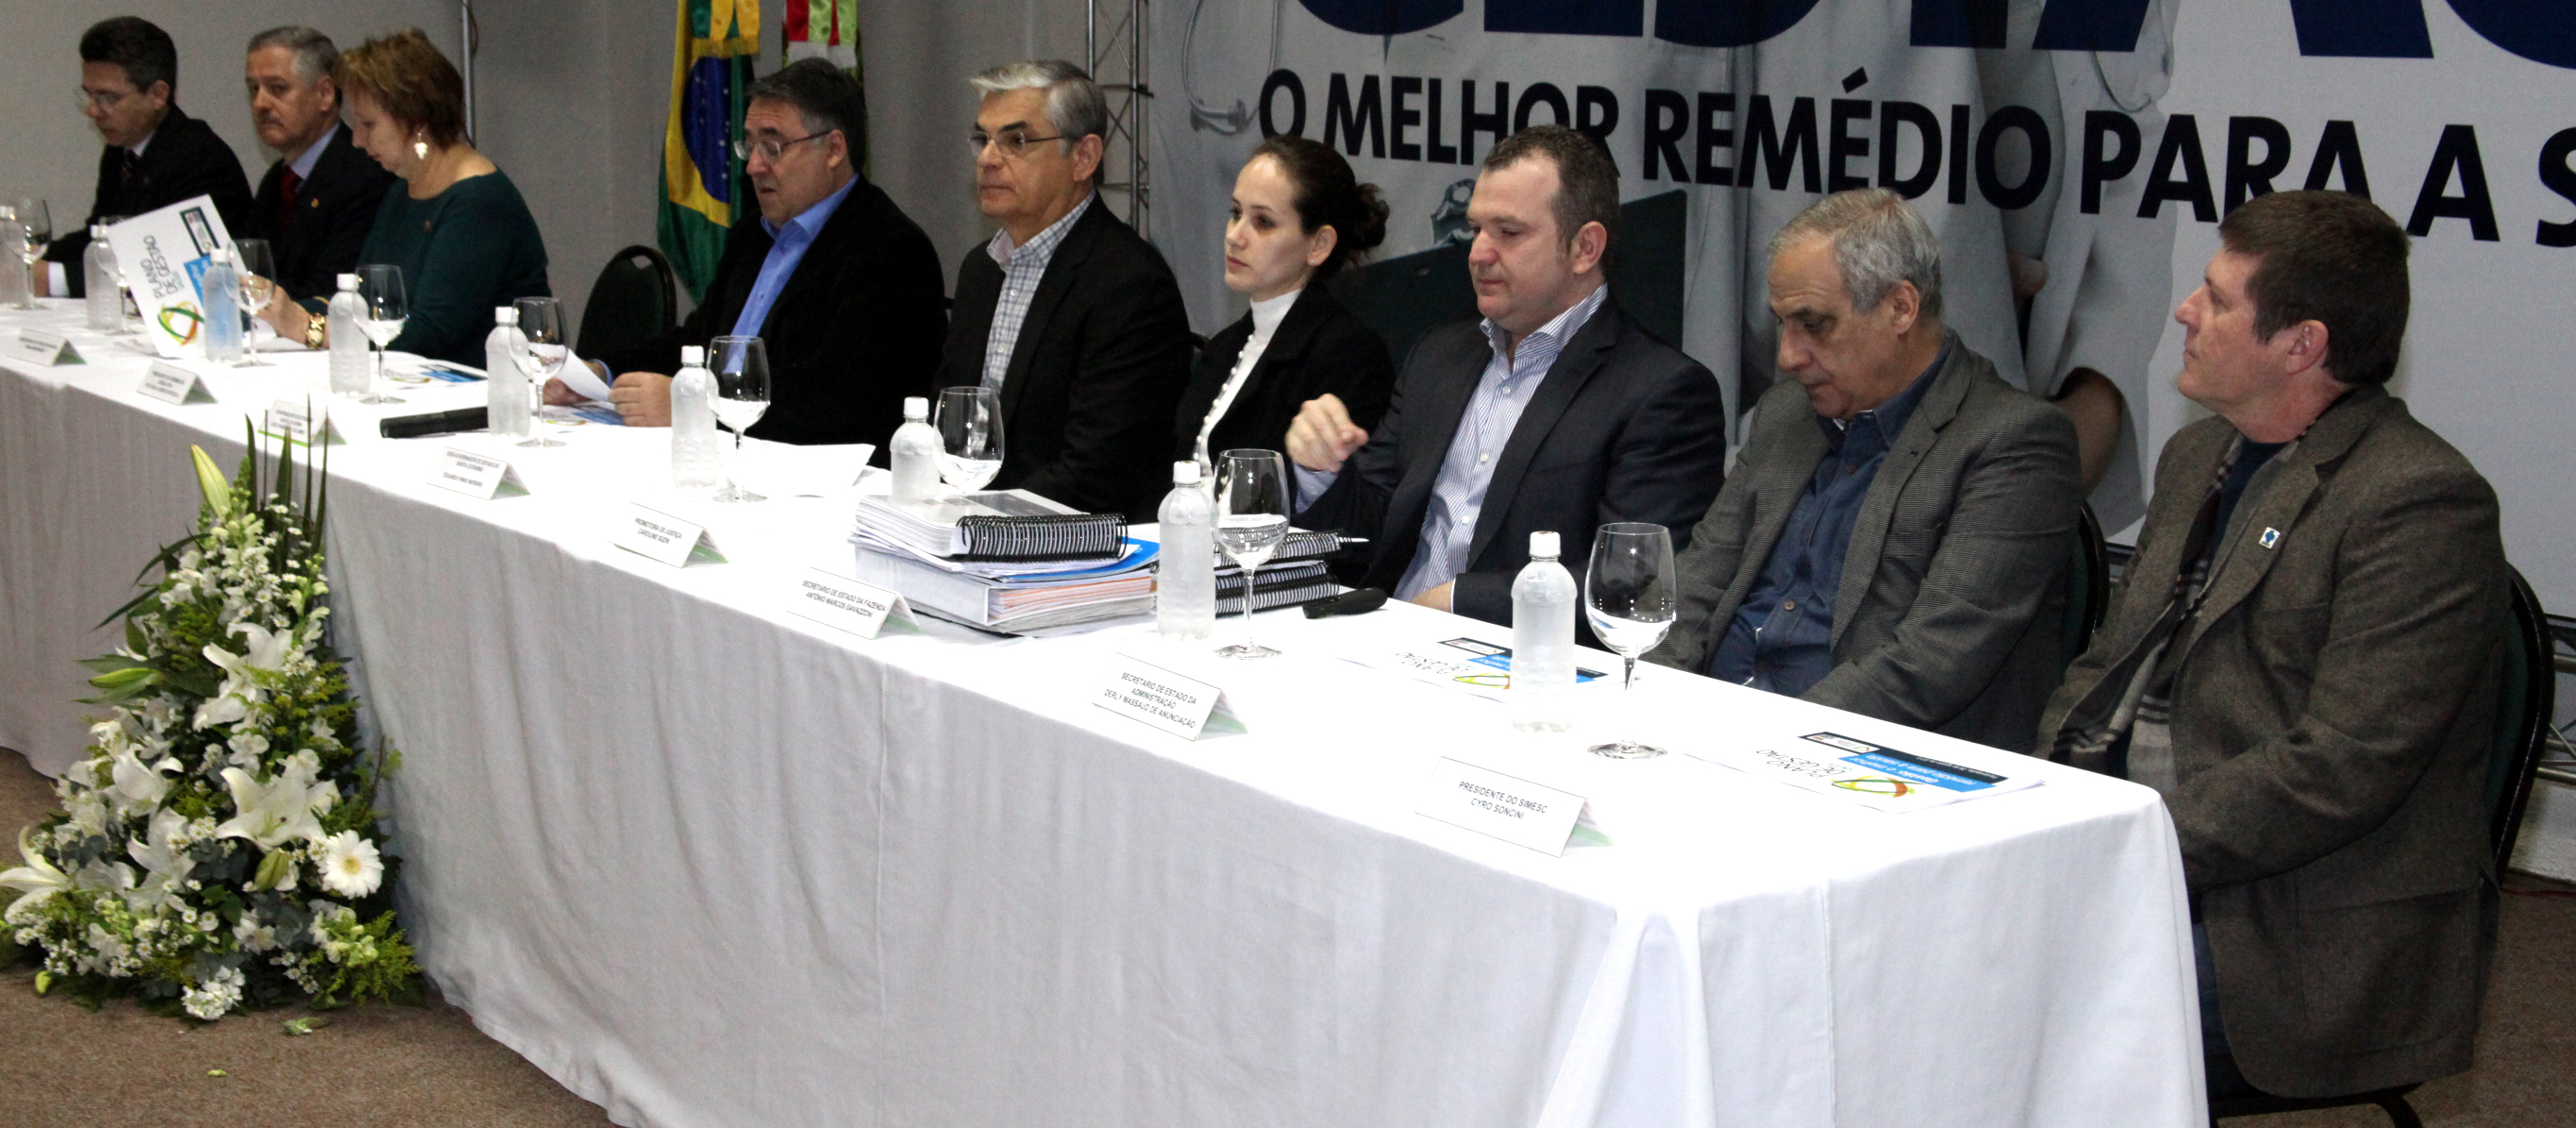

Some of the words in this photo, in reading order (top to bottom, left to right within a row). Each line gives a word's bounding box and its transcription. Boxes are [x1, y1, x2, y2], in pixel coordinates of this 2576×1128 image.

[1260, 68, 1307, 139] O
[1324, 73, 1621, 177] MELHOR
[1643, 66, 2052, 210] REMÉDIO
[2080, 109, 2374, 224] PARA
[2406, 124, 2501, 243] A
[825, 598, 846, 610] MARCOS
[837, 591, 857, 602] ESTADO
[863, 599, 887, 612] FAZENDA
[1104, 688, 1123, 701] DERLY
[1149, 705, 1159, 715] DE
[1156, 684, 1165, 694] DE
[1164, 688, 1188, 701] ESTADO
[1187, 696, 1196, 705] DA
[1459, 781, 1505, 801] PRESIDENTE
[1505, 795, 1518, 805] DO
[1518, 799, 1547, 814] SIMESC
[1470, 798, 1493, 811] CYRO
[1493, 804, 1525, 819] SONCINI
